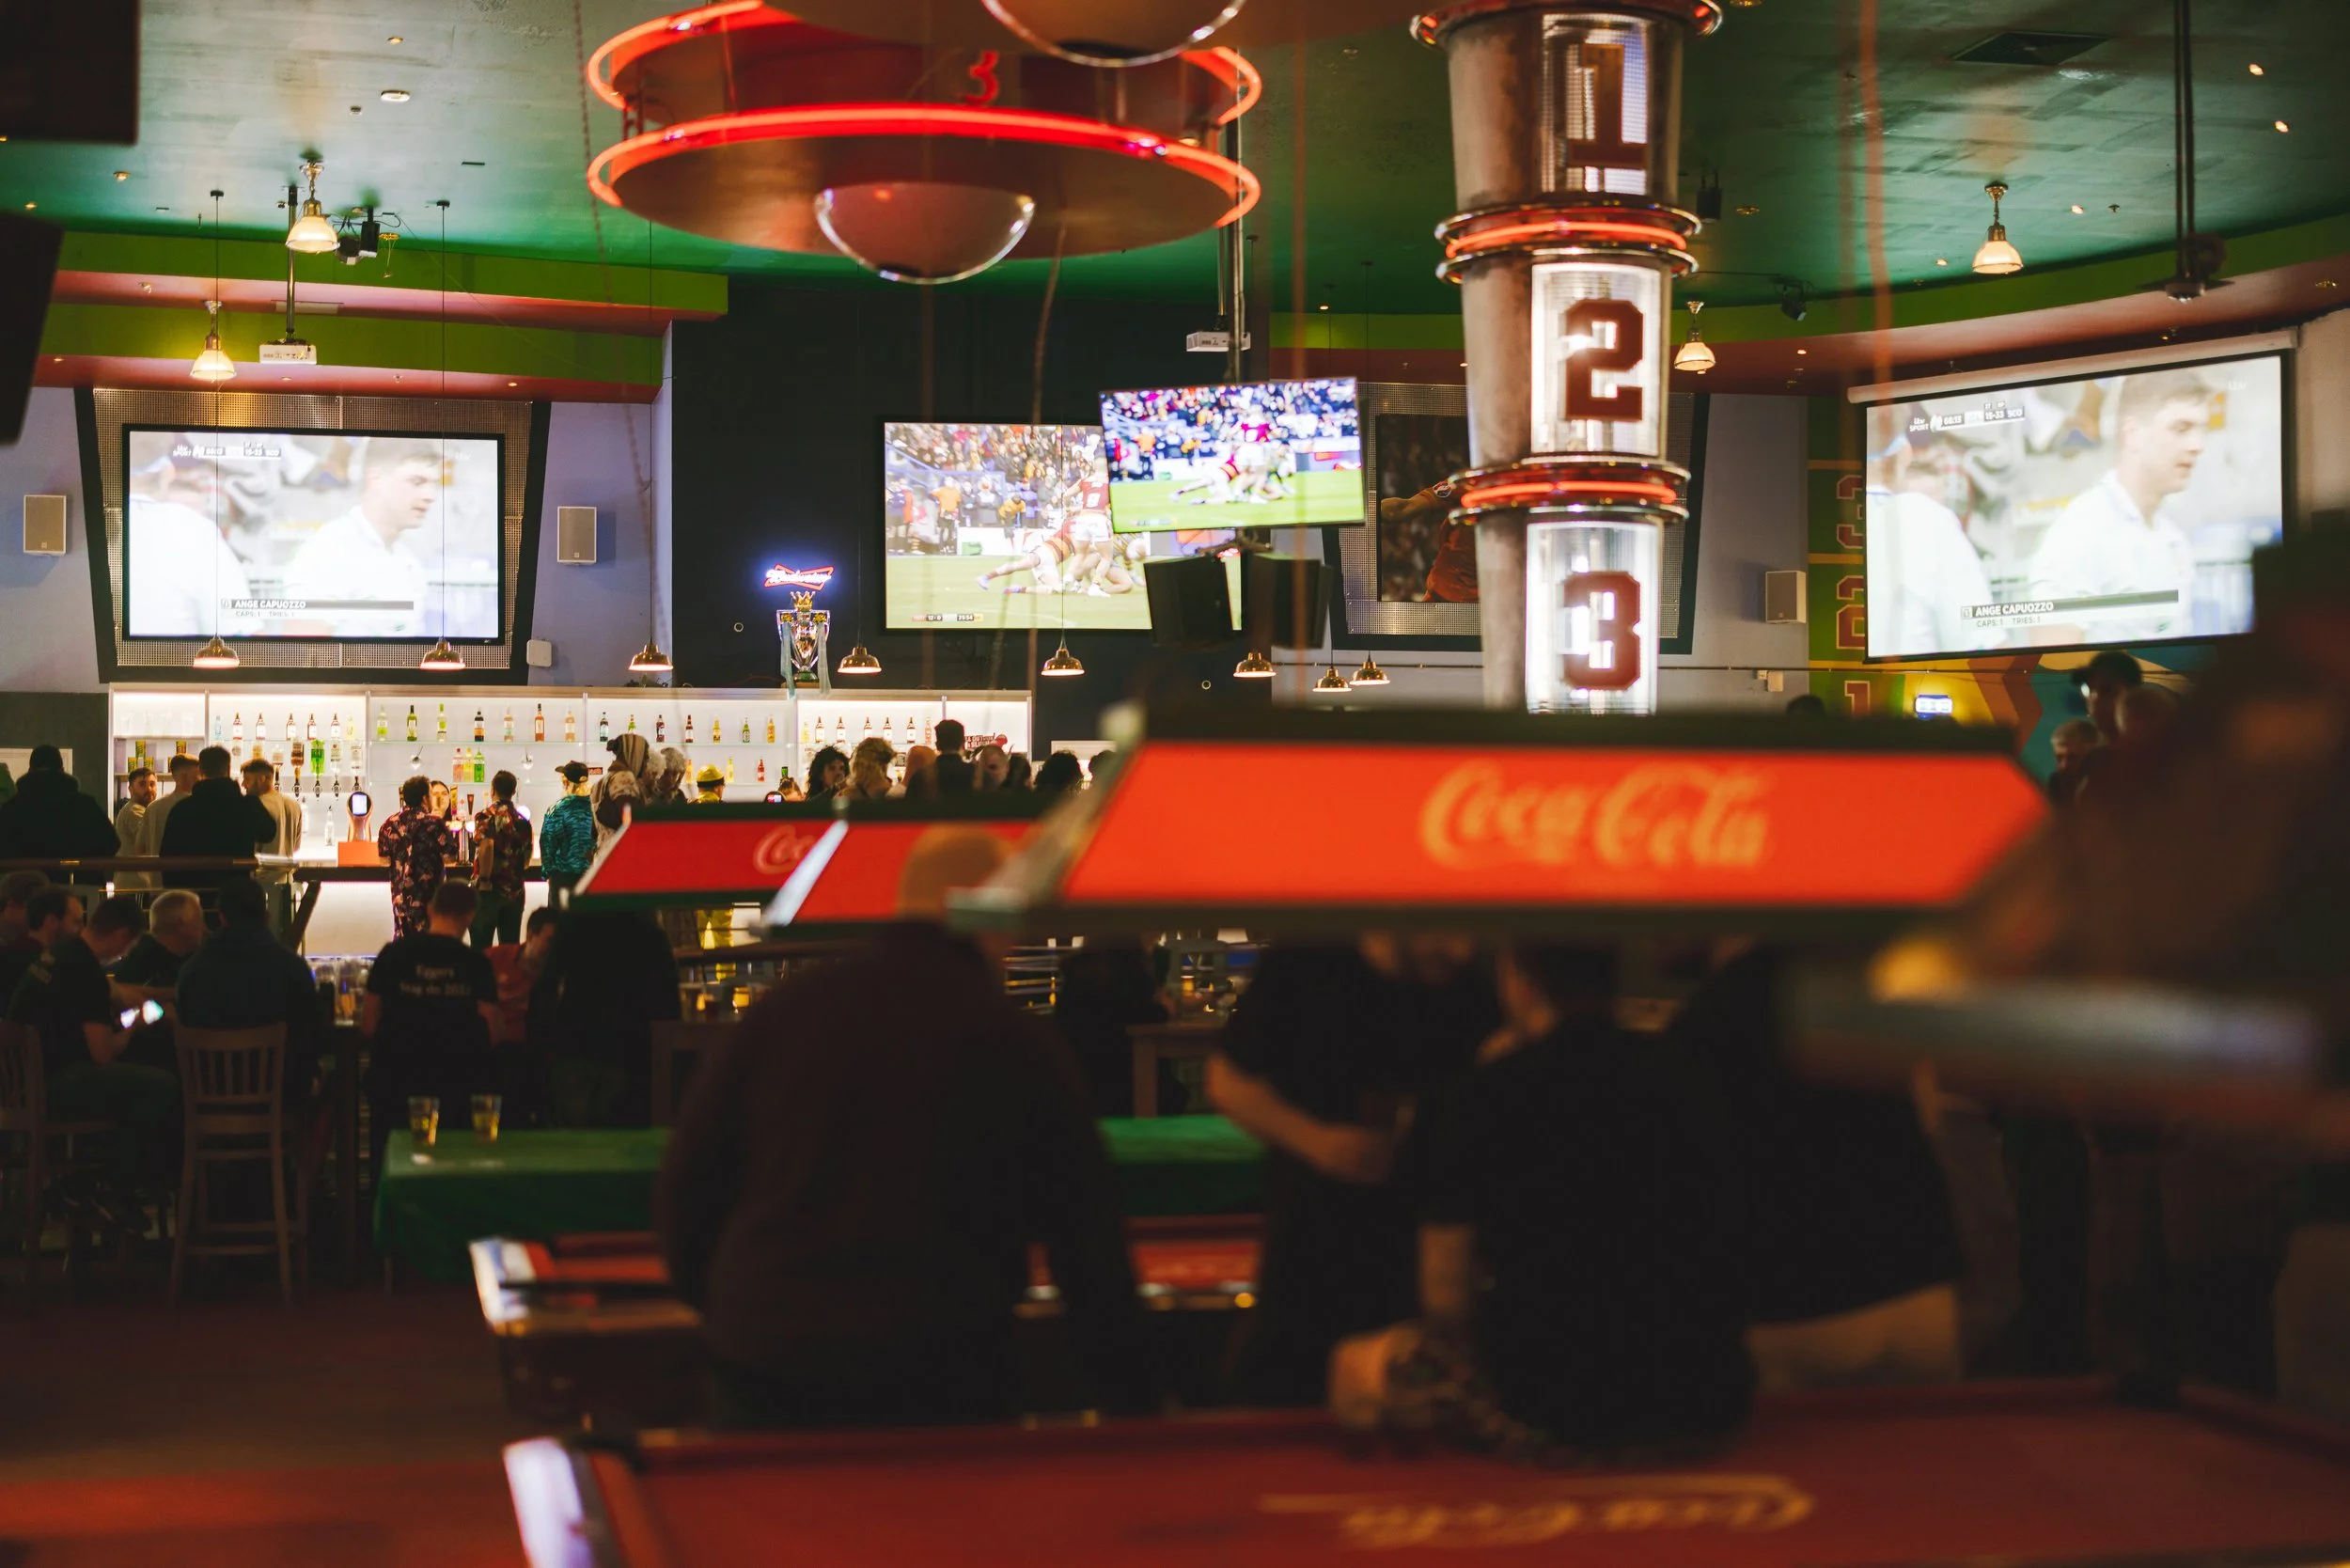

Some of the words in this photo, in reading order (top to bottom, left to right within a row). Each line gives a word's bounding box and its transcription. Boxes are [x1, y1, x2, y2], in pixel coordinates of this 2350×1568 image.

[1567, 43, 1648, 170] 1
[1564, 298, 1643, 422] 2
[235, 600, 258, 609] ANGE
[259, 600, 306, 610] CAPUOZZO
[1563, 571, 1641, 691] 3
[1975, 604, 2001, 618] ANGE
[2002, 602, 2055, 615] CAPUOZZO
